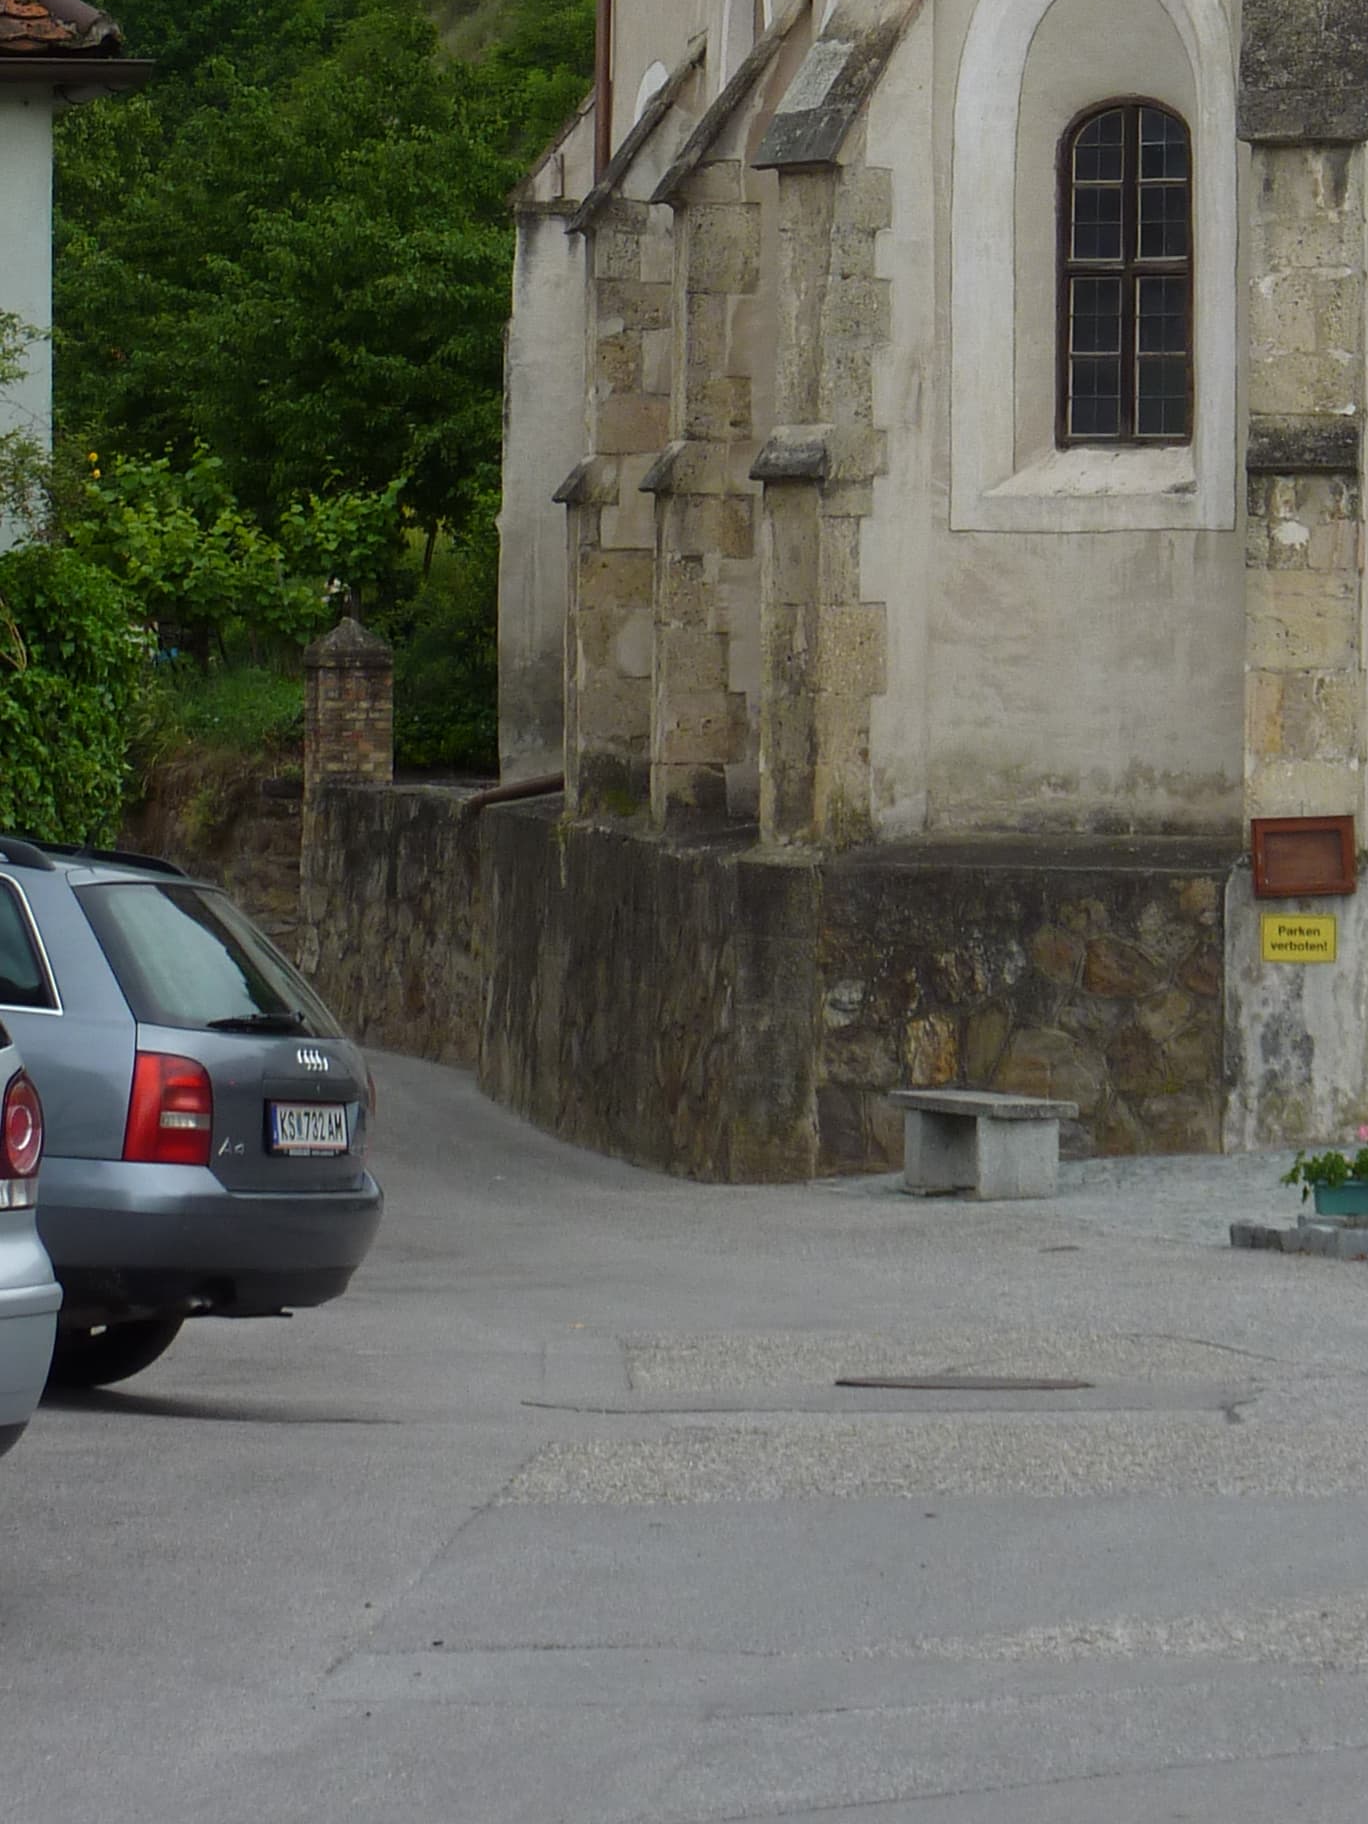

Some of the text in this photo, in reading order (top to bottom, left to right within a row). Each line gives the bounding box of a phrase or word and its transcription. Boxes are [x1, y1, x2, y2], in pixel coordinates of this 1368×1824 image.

[1277, 924, 1321, 937] Parken
[1270, 940, 1328, 952] verboten!
[279, 1110, 344, 1142] KS 732 AM
